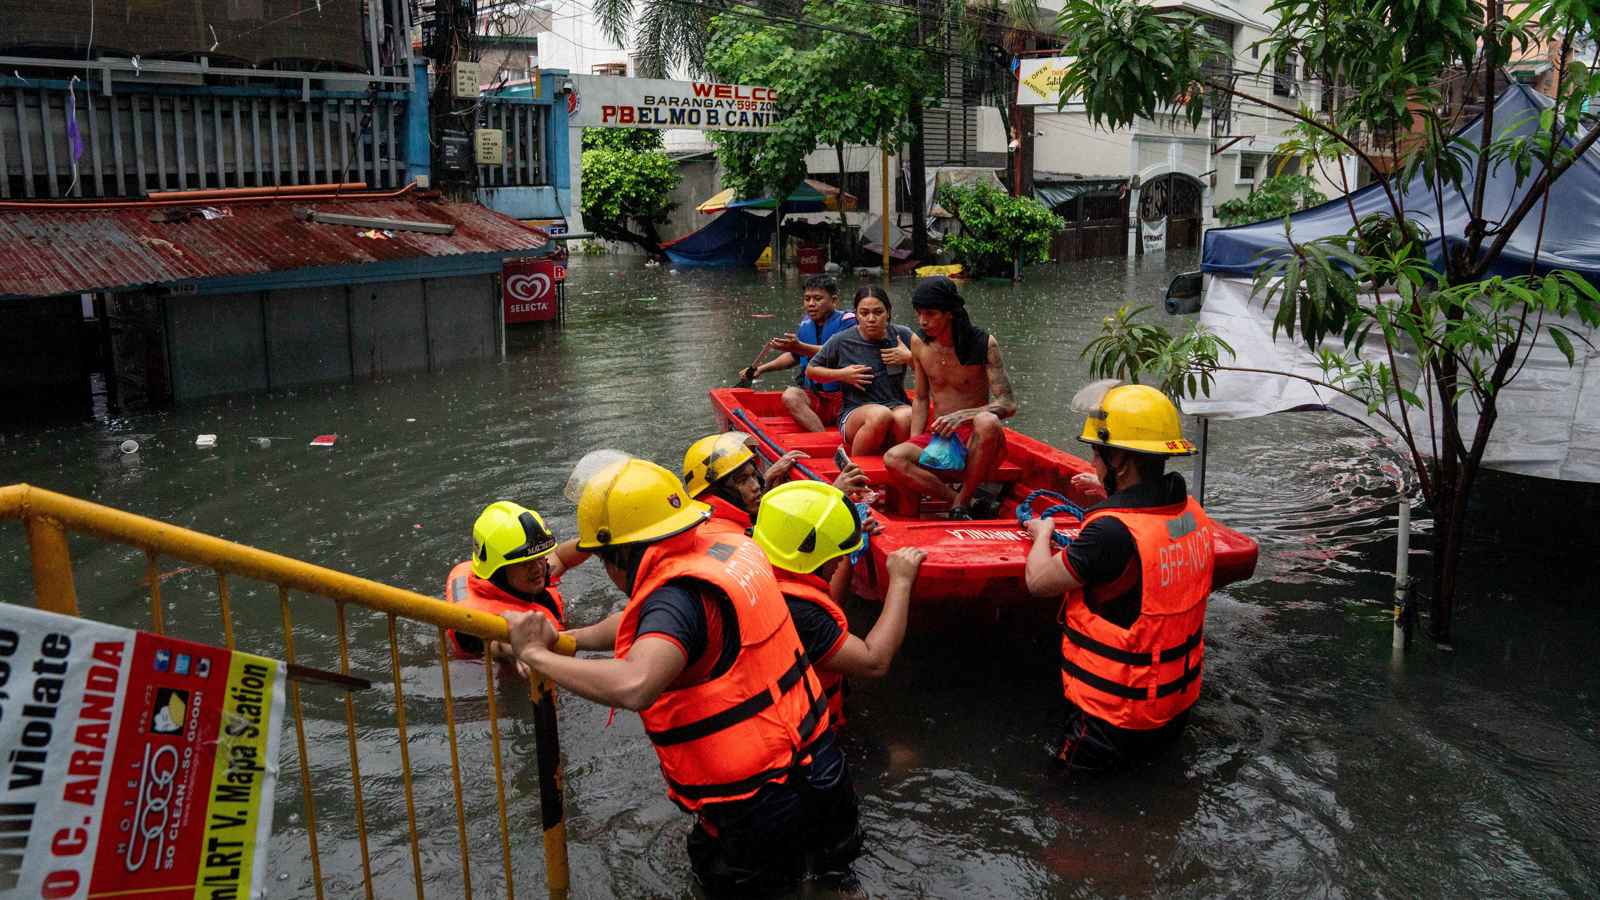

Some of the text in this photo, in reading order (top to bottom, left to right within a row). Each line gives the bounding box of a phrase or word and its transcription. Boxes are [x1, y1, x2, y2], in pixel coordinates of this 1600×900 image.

[1031, 65, 1048, 80] OPEN
[644, 95, 735, 109] BARANGAY
[737, 100, 757, 112] 595
[510, 302, 548, 313] SELECTA
[8, 632, 71, 791] violate
[62, 640, 125, 807] ARANDA
[186, 689, 204, 742] GOOD!
[215, 739, 266, 803] Mapa
[116, 759, 142, 855] HOTEL
[126, 742, 180, 872] SOGO
[210, 808, 249, 832] V.
[51, 817, 93, 857] C.
